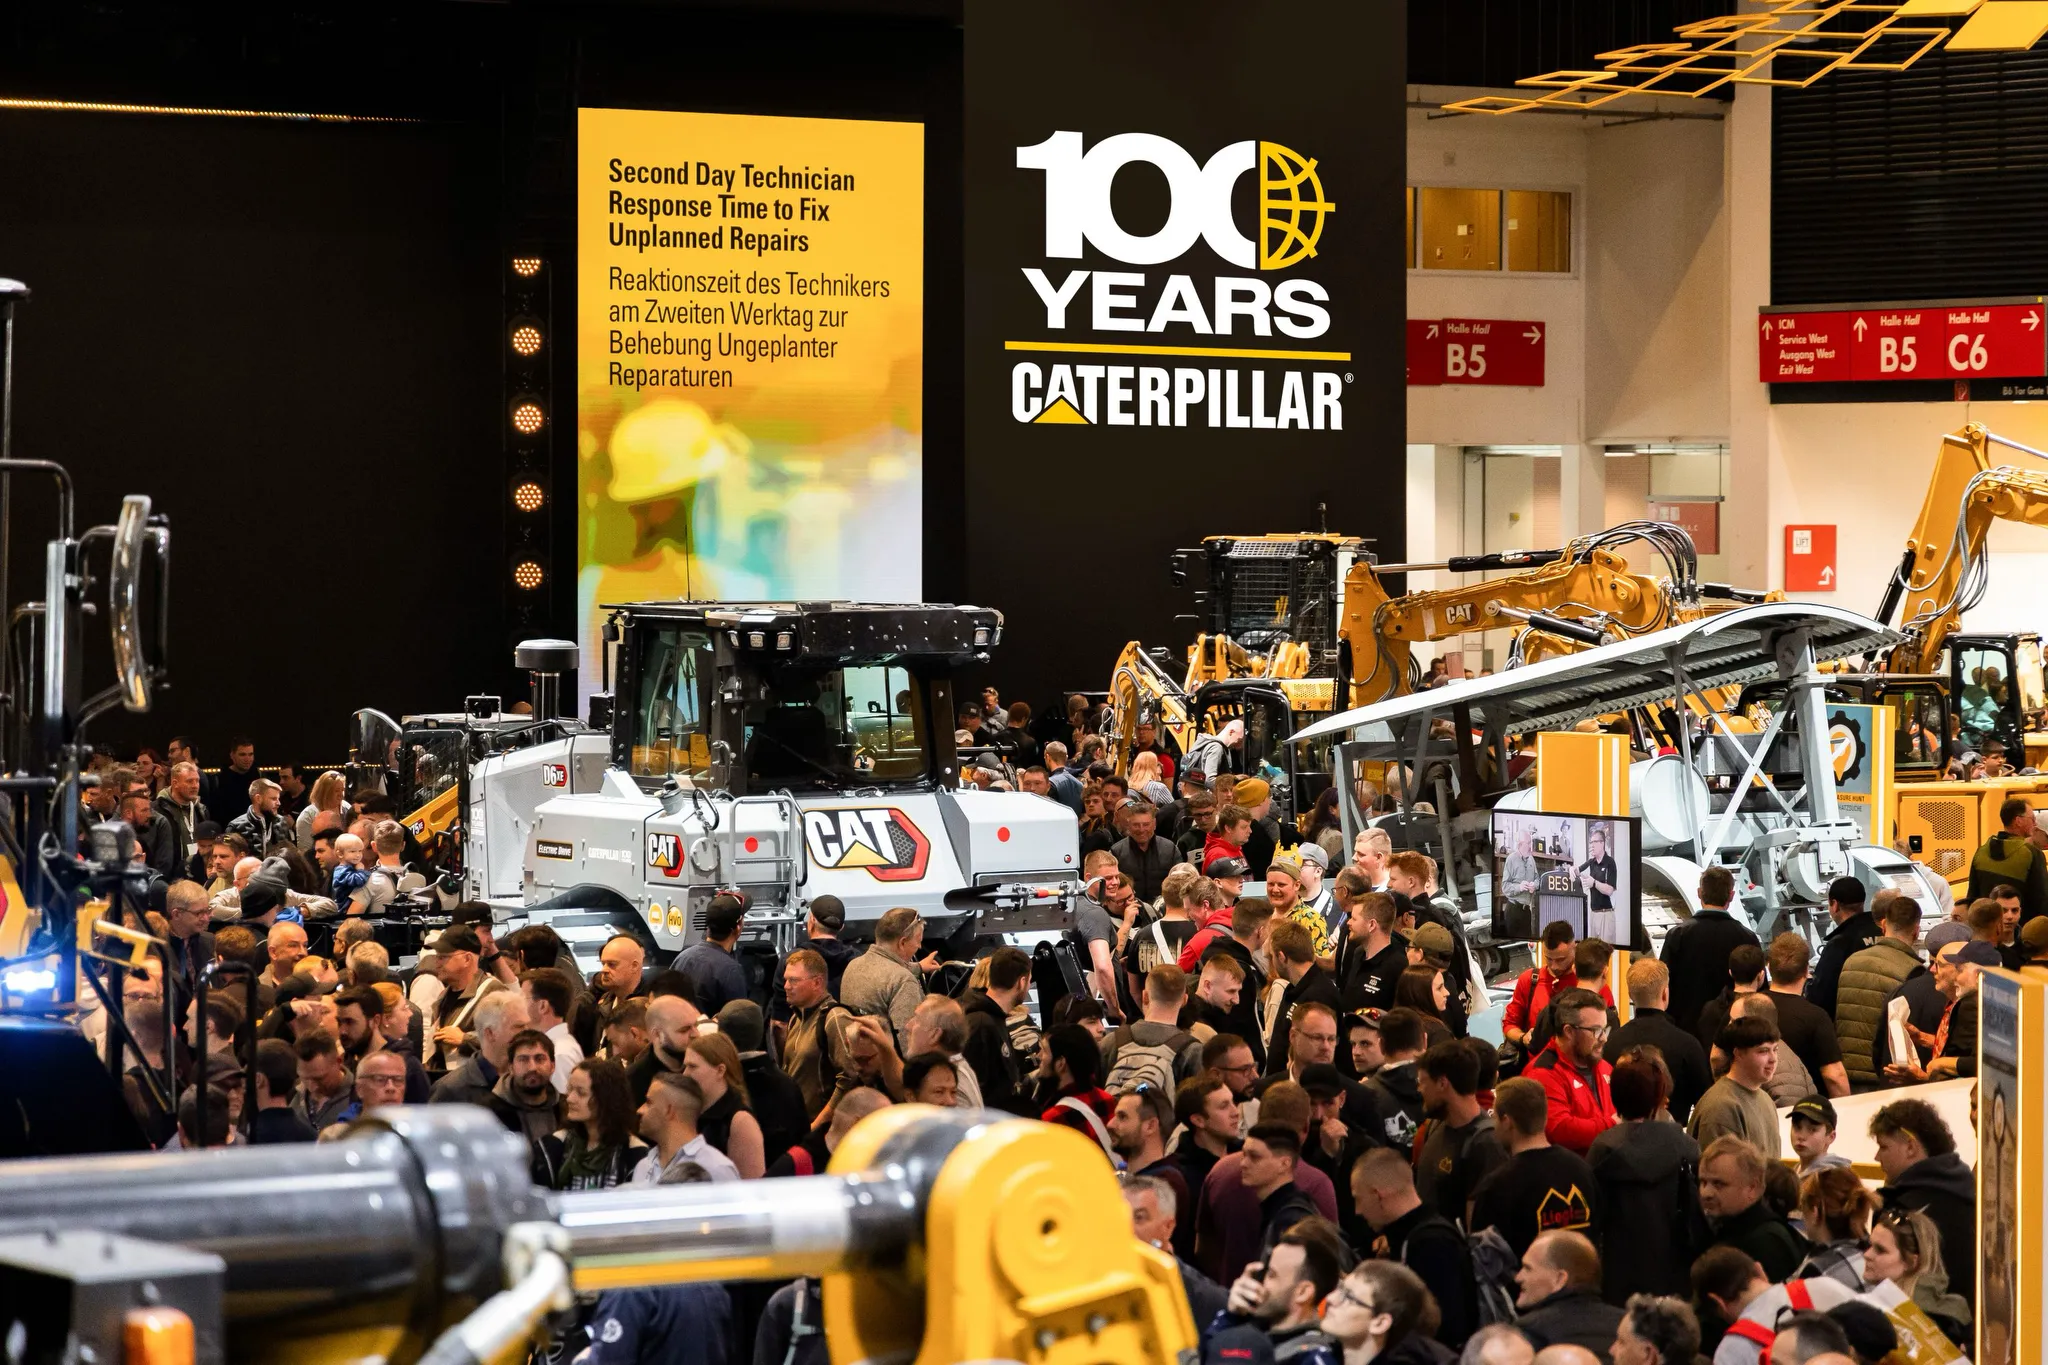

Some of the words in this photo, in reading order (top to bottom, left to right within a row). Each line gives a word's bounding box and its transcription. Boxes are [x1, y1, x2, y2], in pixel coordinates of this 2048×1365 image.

[609, 158, 689, 185] Second
[695, 162, 736, 192] Day
[741, 164, 855, 192] Technician
[609, 190, 712, 222] Response
[718, 194, 767, 220] Time
[773, 198, 793, 221] to
[800, 198, 830, 222] Fix
[1016, 130, 1335, 270] 100
[609, 223, 723, 253] Unplanned
[730, 226, 809, 257] Repairs
[609, 266, 741, 294] Reaktionszeit
[746, 270, 780, 296] des
[786, 271, 890, 298] Technikers
[609, 304, 639, 323] am
[645, 299, 725, 325] Zweiten
[730, 301, 813, 333] Werktag
[818, 308, 848, 328] zur
[1021, 268, 1331, 339] YEARS
[1948, 312, 1971, 324] Halle
[1972, 311, 1991, 324] Hall
[1447, 323, 1470, 334] Halle
[1472, 324, 1491, 335] Hall
[1778, 319, 1795, 330] ICM
[1880, 315, 1901, 327] Halle
[1903, 314, 1921, 326] Hall
[609, 330, 712, 361] Behebung
[718, 333, 838, 362] Ungeplanter
[1779, 334, 1807, 345] Service
[1808, 333, 1828, 344] West
[1948, 333, 1988, 372] C6
[1447, 343, 1487, 378] B5
[1779, 349, 1815, 362] Ausgang
[1816, 348, 1836, 359] West
[1779, 365, 1794, 375] Exit
[1795, 364, 1814, 375] West
[1880, 336, 1917, 373] B5
[609, 362, 733, 391] Reparaturen
[2014, 386, 2025, 395] Tor
[2027, 385, 2044, 396] Gate
[1795, 537, 1809, 547] LIFT
[1445, 603, 1472, 625] CAT
[1837, 794, 1851, 802] ASURE
[648, 833, 676, 867] CAT
[804, 809, 899, 867] CAT
[668, 916, 682, 926] HVO
